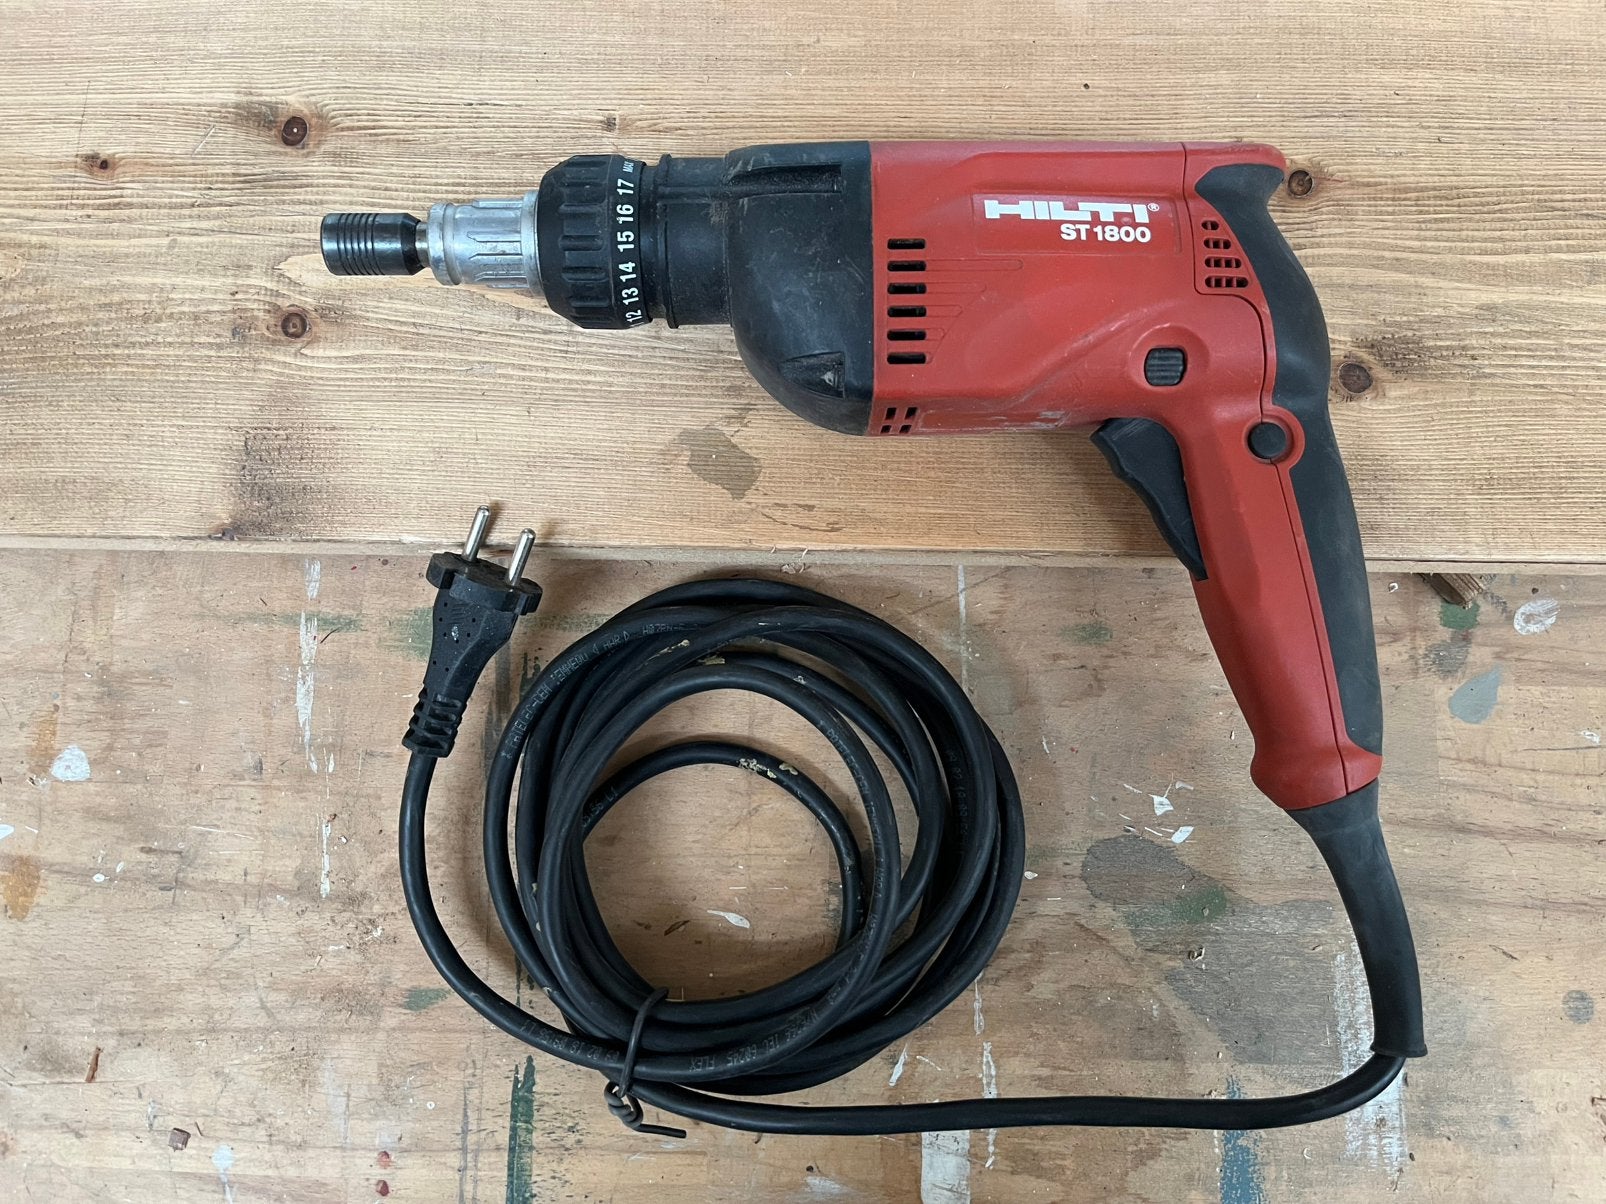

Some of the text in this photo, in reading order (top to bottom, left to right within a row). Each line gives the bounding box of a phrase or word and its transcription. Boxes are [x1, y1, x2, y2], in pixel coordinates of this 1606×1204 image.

[622, 160, 635, 174] MAX
[616, 178, 635, 196] 17
[616, 204, 634, 225] 16
[983, 199, 1150, 223] HILTI
[617, 230, 635, 253] 15
[1060, 223, 1152, 243] ST 1800
[618, 261, 637, 283] 14
[621, 287, 640, 306] 13
[625, 309, 643, 323] 12
